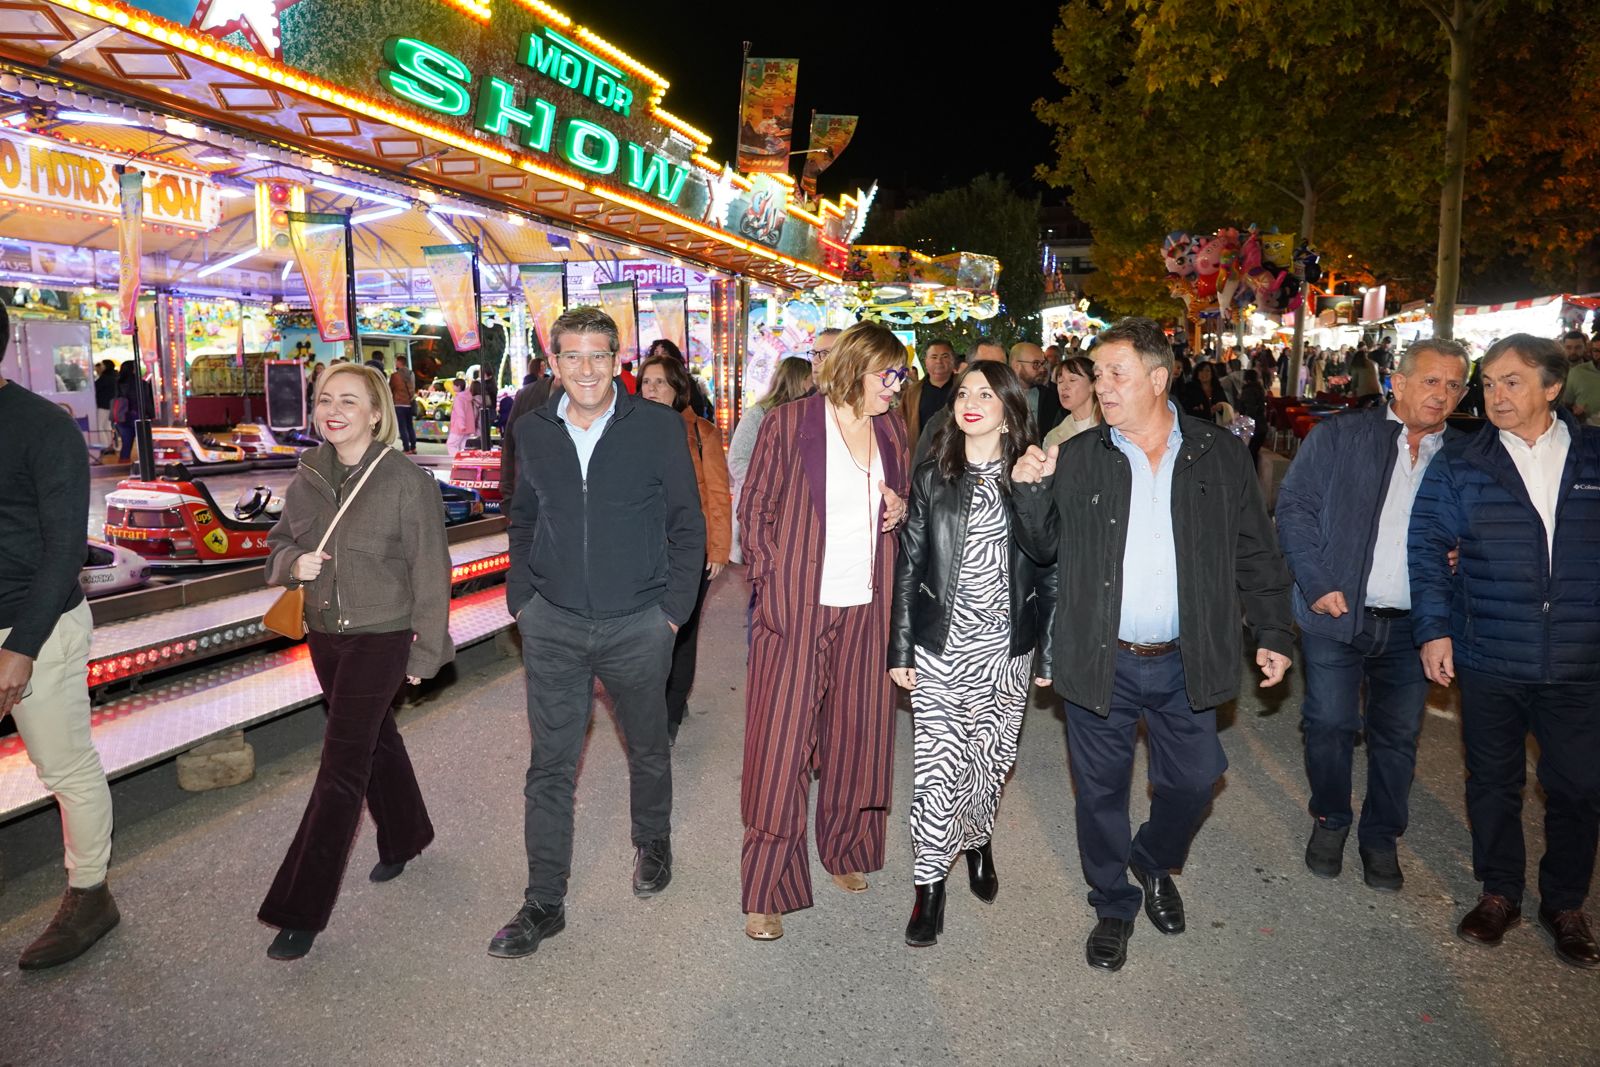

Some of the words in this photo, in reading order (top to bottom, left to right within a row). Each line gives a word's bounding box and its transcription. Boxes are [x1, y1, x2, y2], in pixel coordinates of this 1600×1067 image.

[519, 26, 634, 117] MOTOR
[380, 36, 689, 204] SHOW
[29, 145, 108, 204] MOTOR
[624, 264, 684, 287] aprilia
[106, 525, 147, 539] Ferrari
[195, 510, 212, 524] ups
